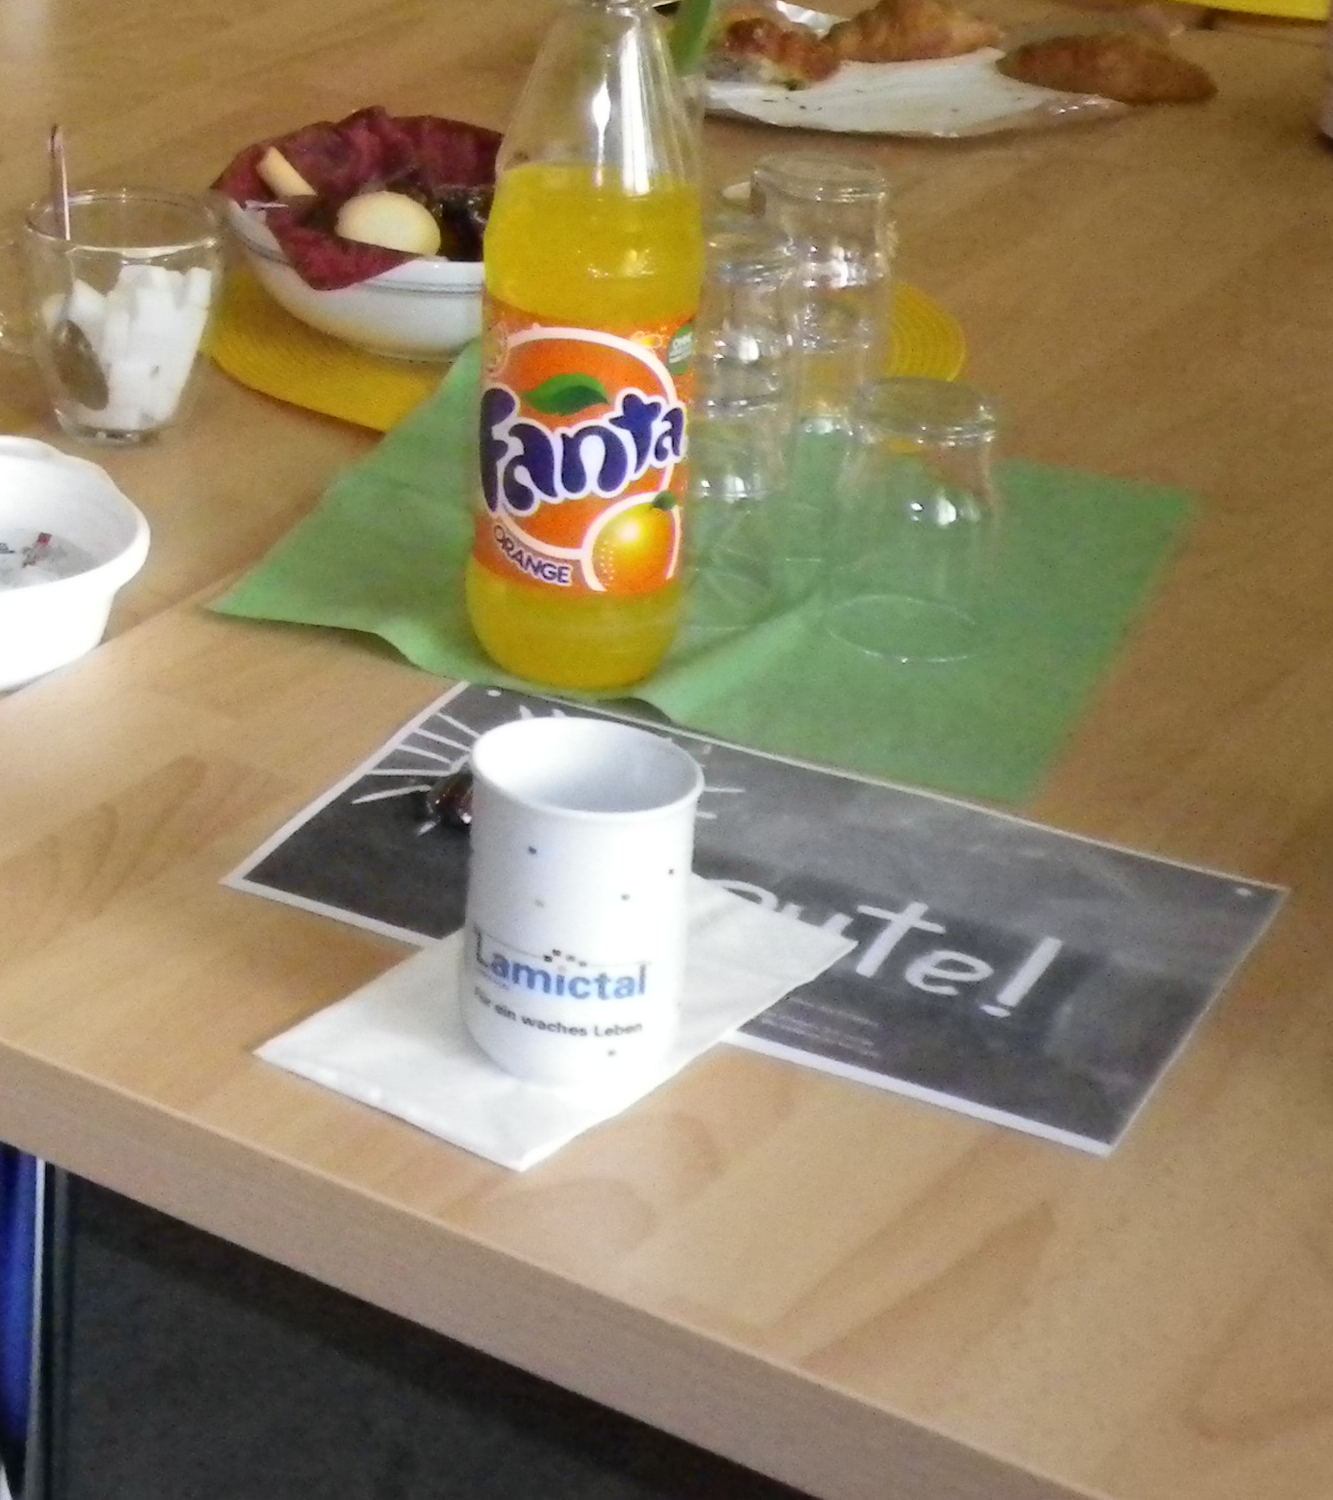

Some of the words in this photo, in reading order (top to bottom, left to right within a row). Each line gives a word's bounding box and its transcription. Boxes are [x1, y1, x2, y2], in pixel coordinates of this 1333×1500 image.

[480, 387, 684, 513] Fanta
[492, 524, 572, 585] ORANGE
[475, 928, 647, 1001] Lamictal
[494, 1004, 517, 1021] ein
[521, 1015, 587, 1037] waches
[594, 1022, 643, 1038] Leben
